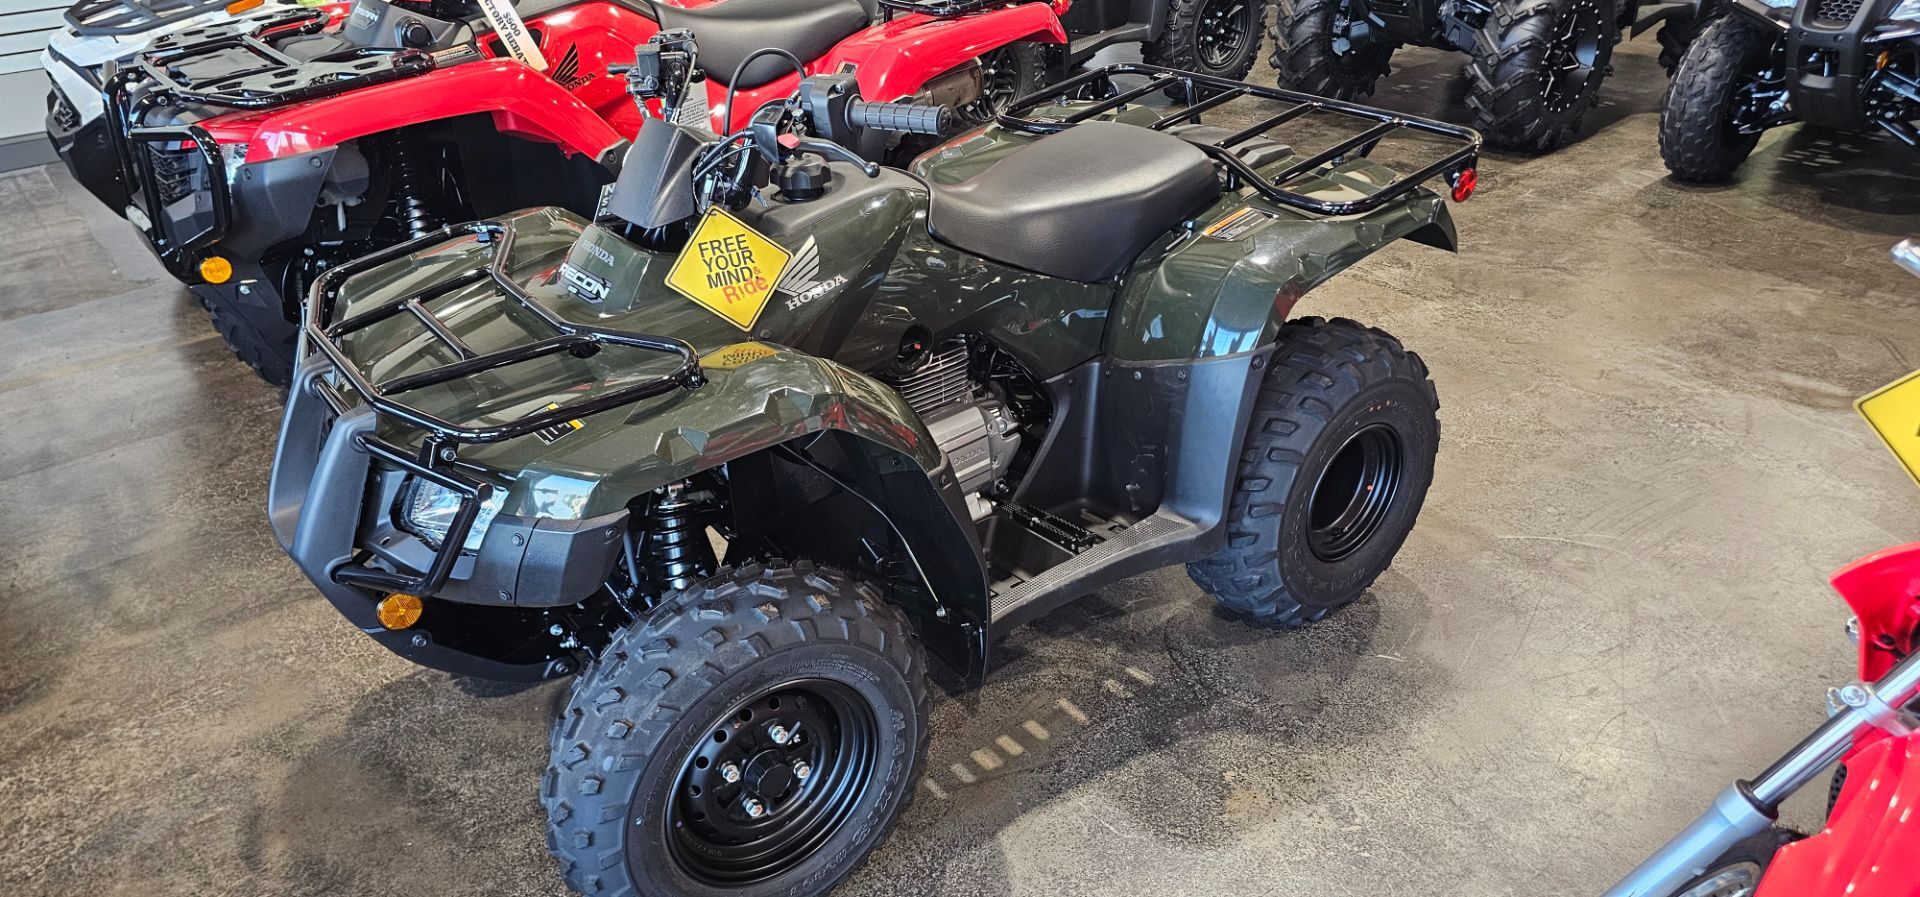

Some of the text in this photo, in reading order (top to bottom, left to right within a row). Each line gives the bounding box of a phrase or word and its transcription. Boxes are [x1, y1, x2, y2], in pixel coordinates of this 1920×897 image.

[580, 240, 614, 267] HONDA
[698, 233, 749, 258] FREE
[702, 249, 755, 273] YOUR
[558, 262, 610, 299] RECON
[722, 276, 769, 304] Ride
[785, 273, 848, 311] HONDA
